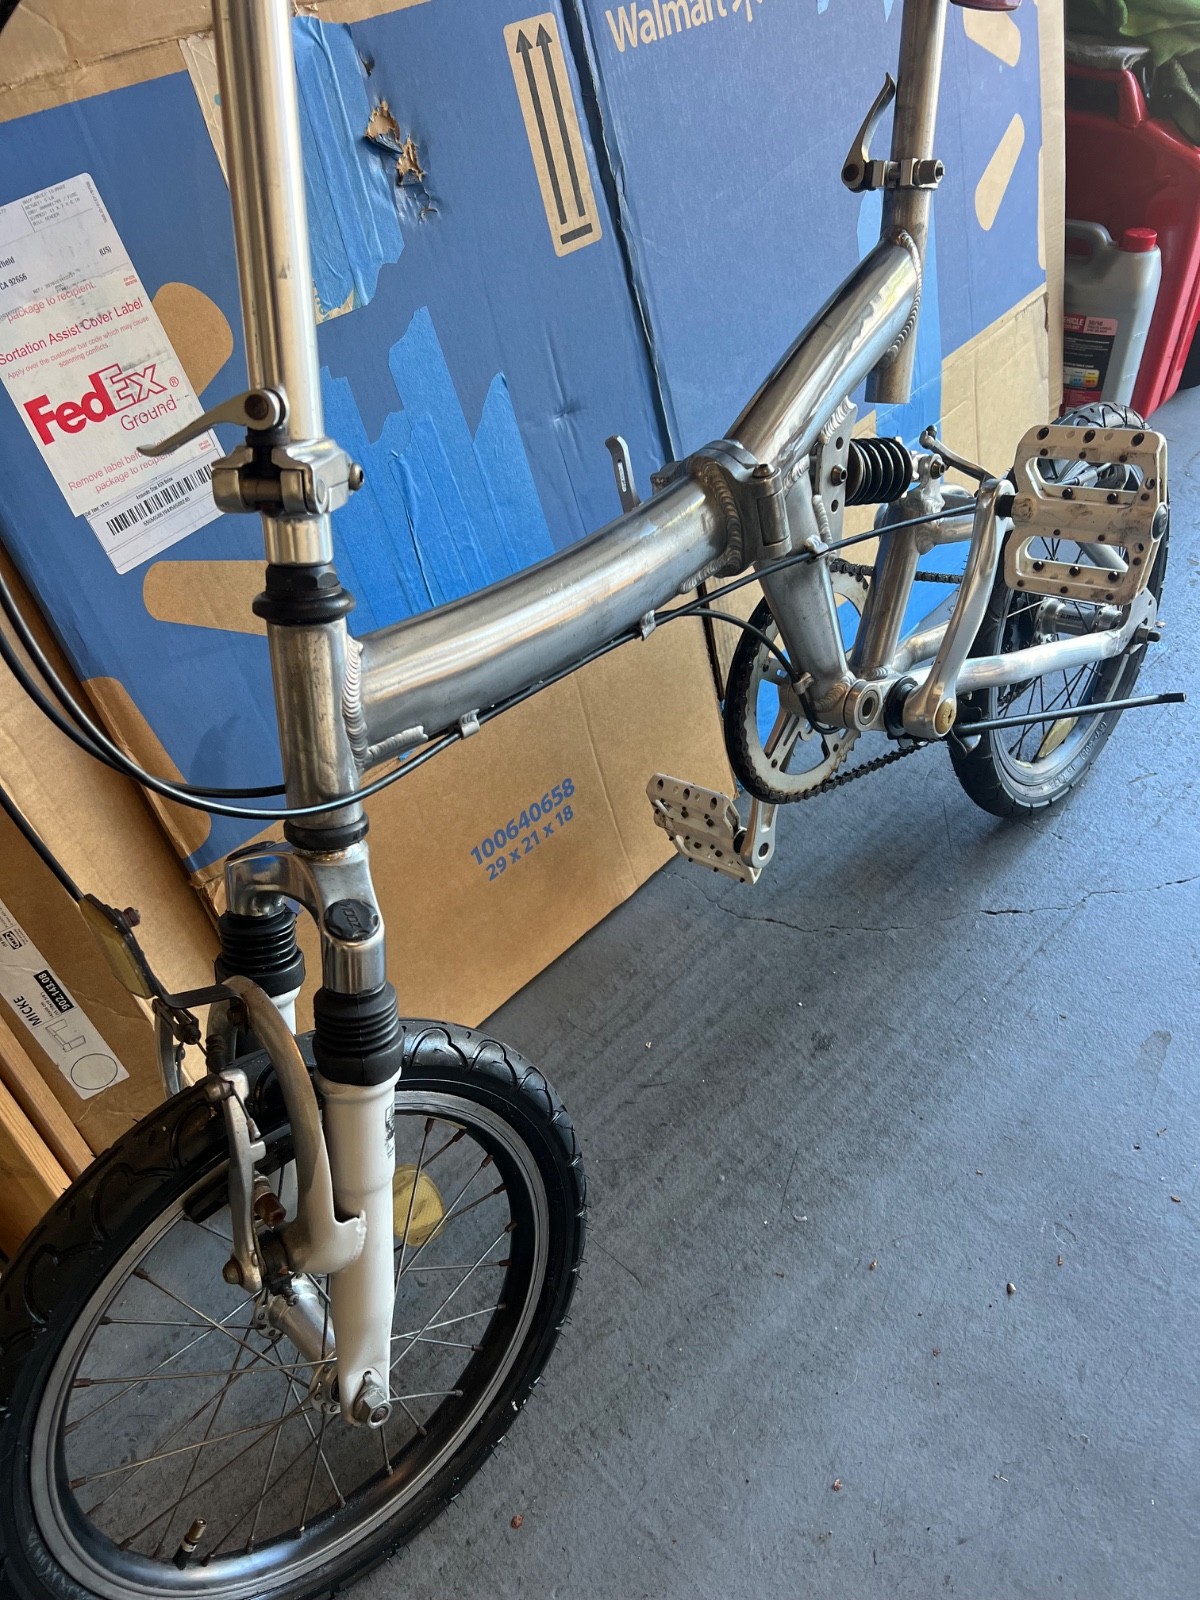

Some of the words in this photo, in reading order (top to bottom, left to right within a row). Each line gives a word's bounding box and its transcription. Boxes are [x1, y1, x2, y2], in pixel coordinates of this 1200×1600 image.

[605, 0, 728, 52] Walmart
[7, 302, 46, 324] package
[46, 297, 56, 307] to
[58, 281, 97, 301] recipient.
[0, 339, 47, 365] Sortation
[48, 323, 82, 346] Assist
[81, 311, 113, 331] Cover
[114, 297, 144, 317] Label
[7, 367, 25, 380] Apply
[25, 362, 39, 372] over
[39, 357, 50, 367] the
[50, 346, 77, 361] customer
[77, 341, 87, 351] bar
[88, 335, 103, 346] code
[103, 328, 120, 340] which
[120, 323, 133, 334] may
[133, 315, 150, 327] cause
[59, 352, 86, 369] scanning
[86, 342, 110, 357] conflicts.
[23, 363, 168, 446] FedEx
[121, 394, 178, 432] Ground
[68, 469, 104, 491] Remove
[104, 459, 125, 474] label
[124, 450, 144, 464] befo
[95, 471, 130, 494] package
[129, 466, 139, 476] to
[470, 778, 575, 865] 100640658
[486, 856, 507, 881] 29
[509, 848, 522, 864] x
[521, 830, 540, 854] 21
[542, 822, 554, 838] x
[555, 805, 574, 827] 18
[13, 995, 42, 1026] MICKE
[38, 972, 70, 1010] 902.143.08
